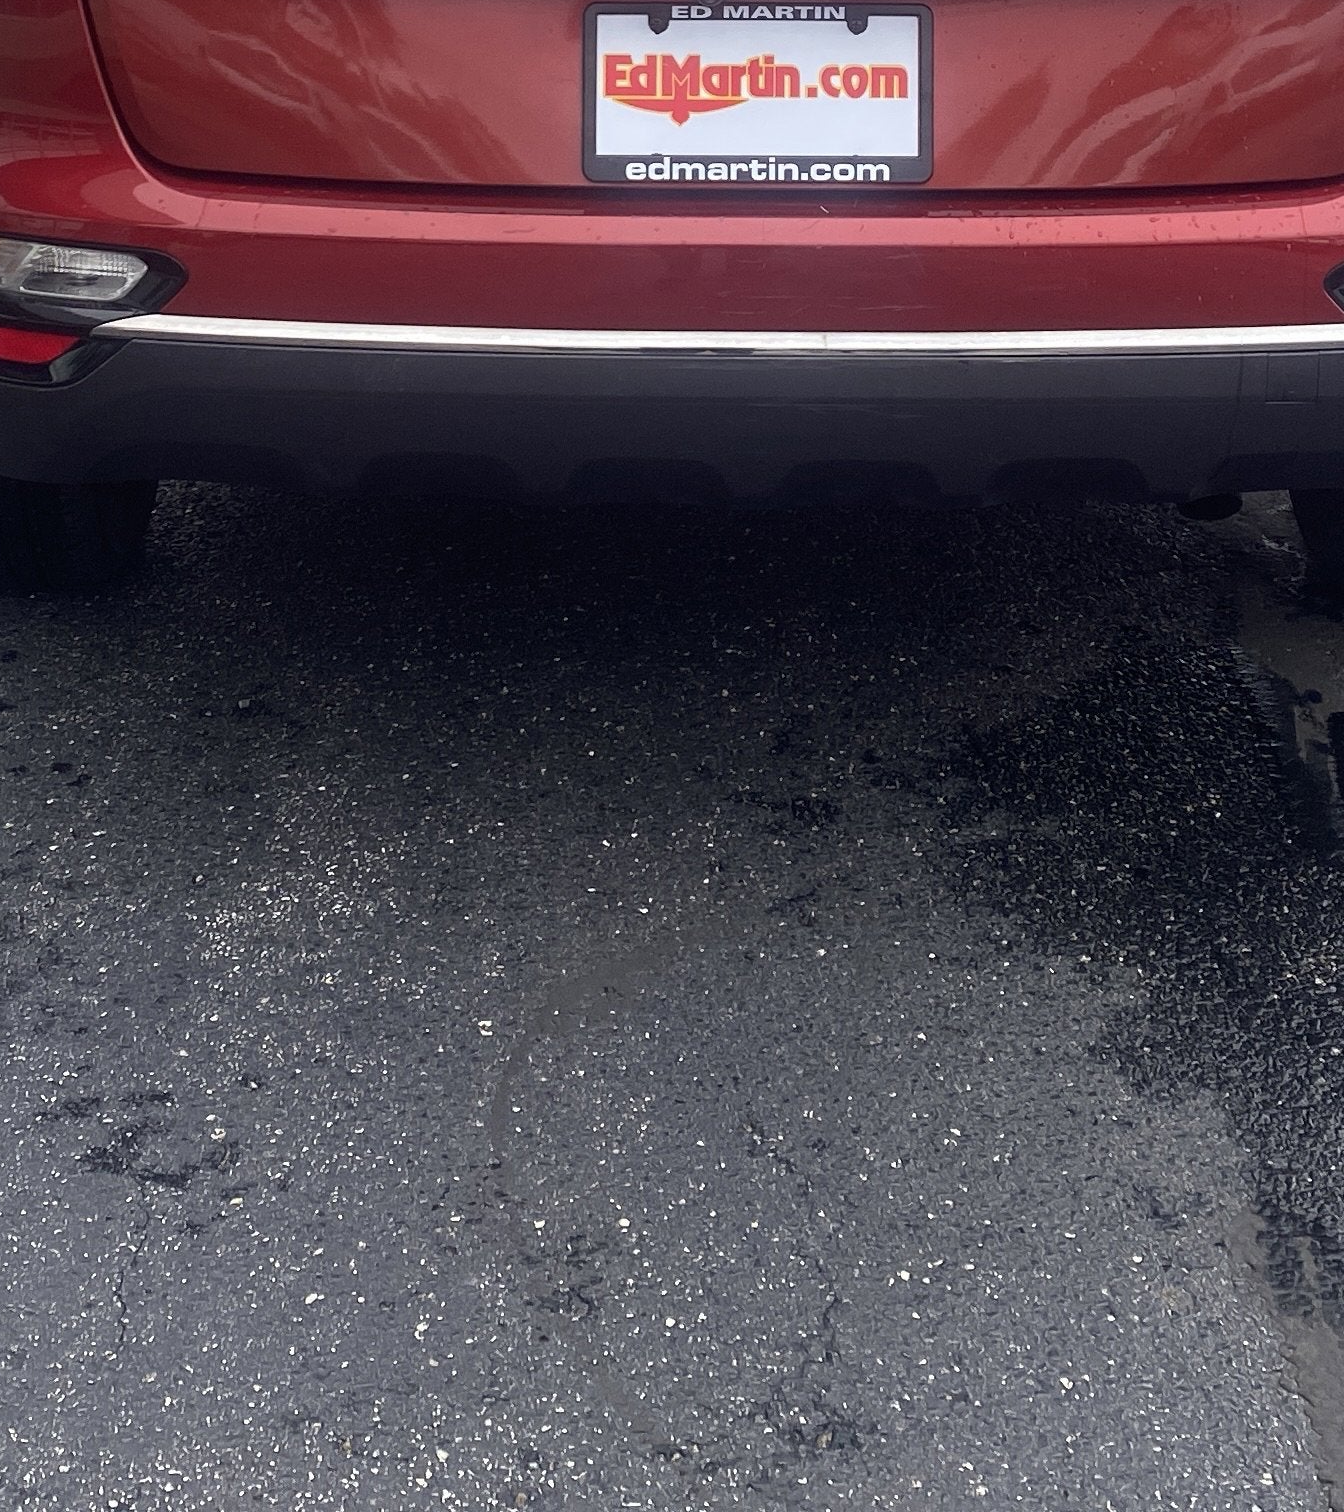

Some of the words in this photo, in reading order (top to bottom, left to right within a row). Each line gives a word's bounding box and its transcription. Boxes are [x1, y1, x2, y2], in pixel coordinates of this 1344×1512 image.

[670, 5, 712, 19] ED
[722, 5, 846, 20] MARTIN
[624, 156, 891, 183] edmartin.com
